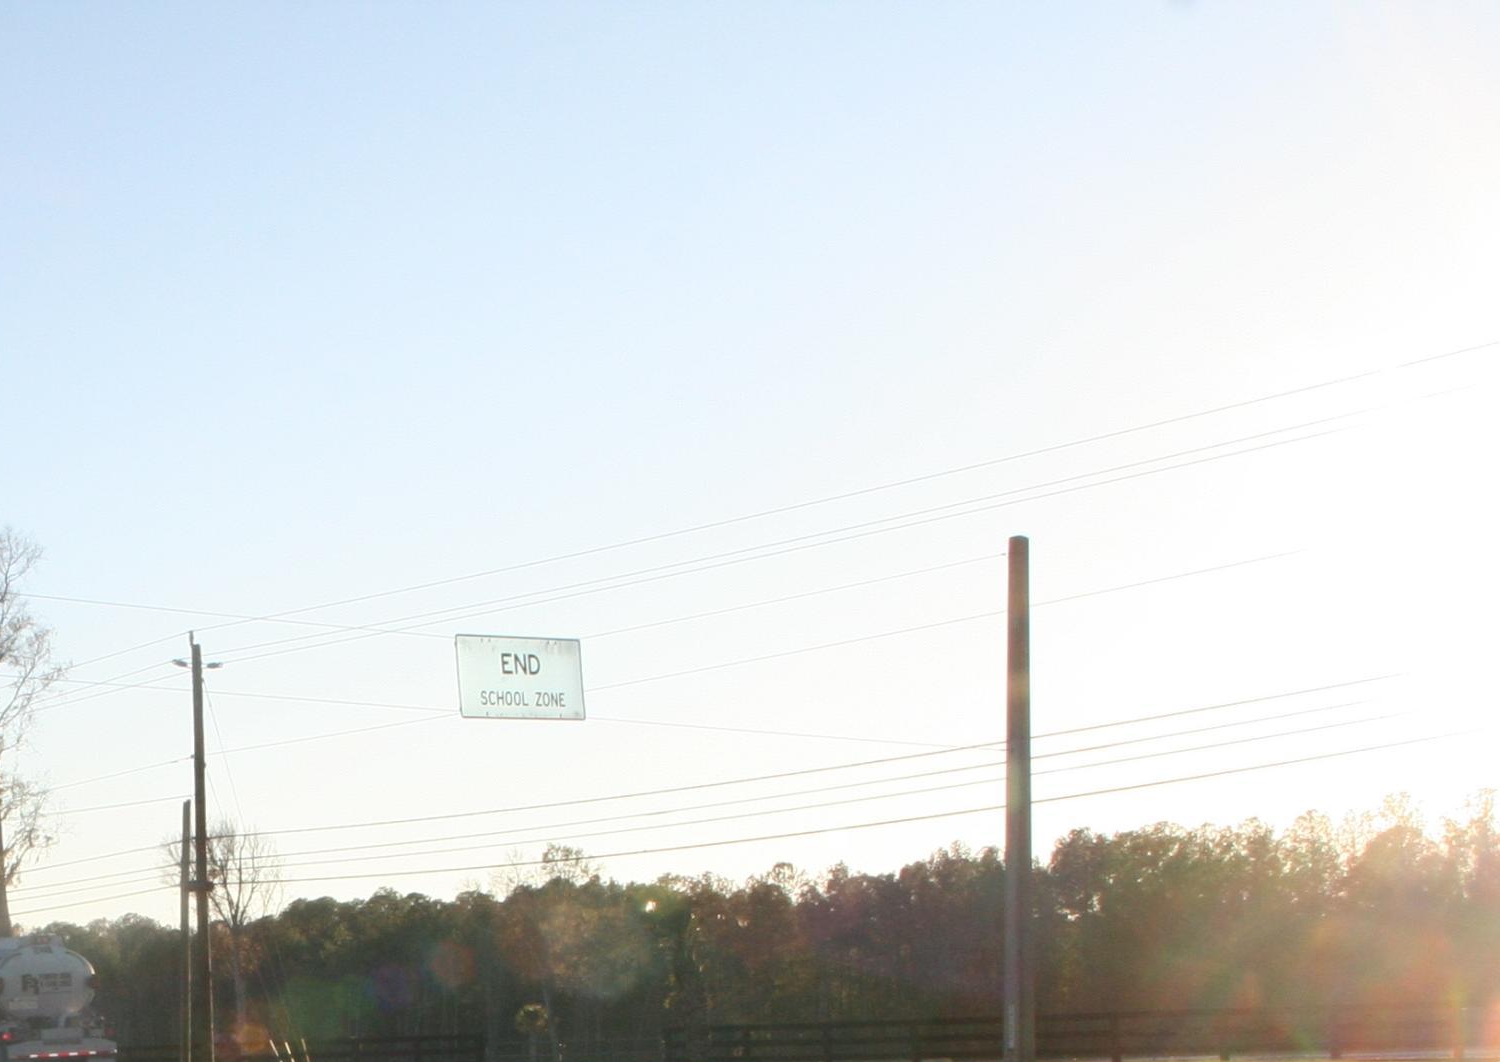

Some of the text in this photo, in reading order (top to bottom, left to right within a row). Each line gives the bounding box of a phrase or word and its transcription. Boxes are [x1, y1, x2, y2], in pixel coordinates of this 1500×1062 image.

[501, 653, 541, 675] END
[480, 690, 566, 707] SCHOOL ZONE
